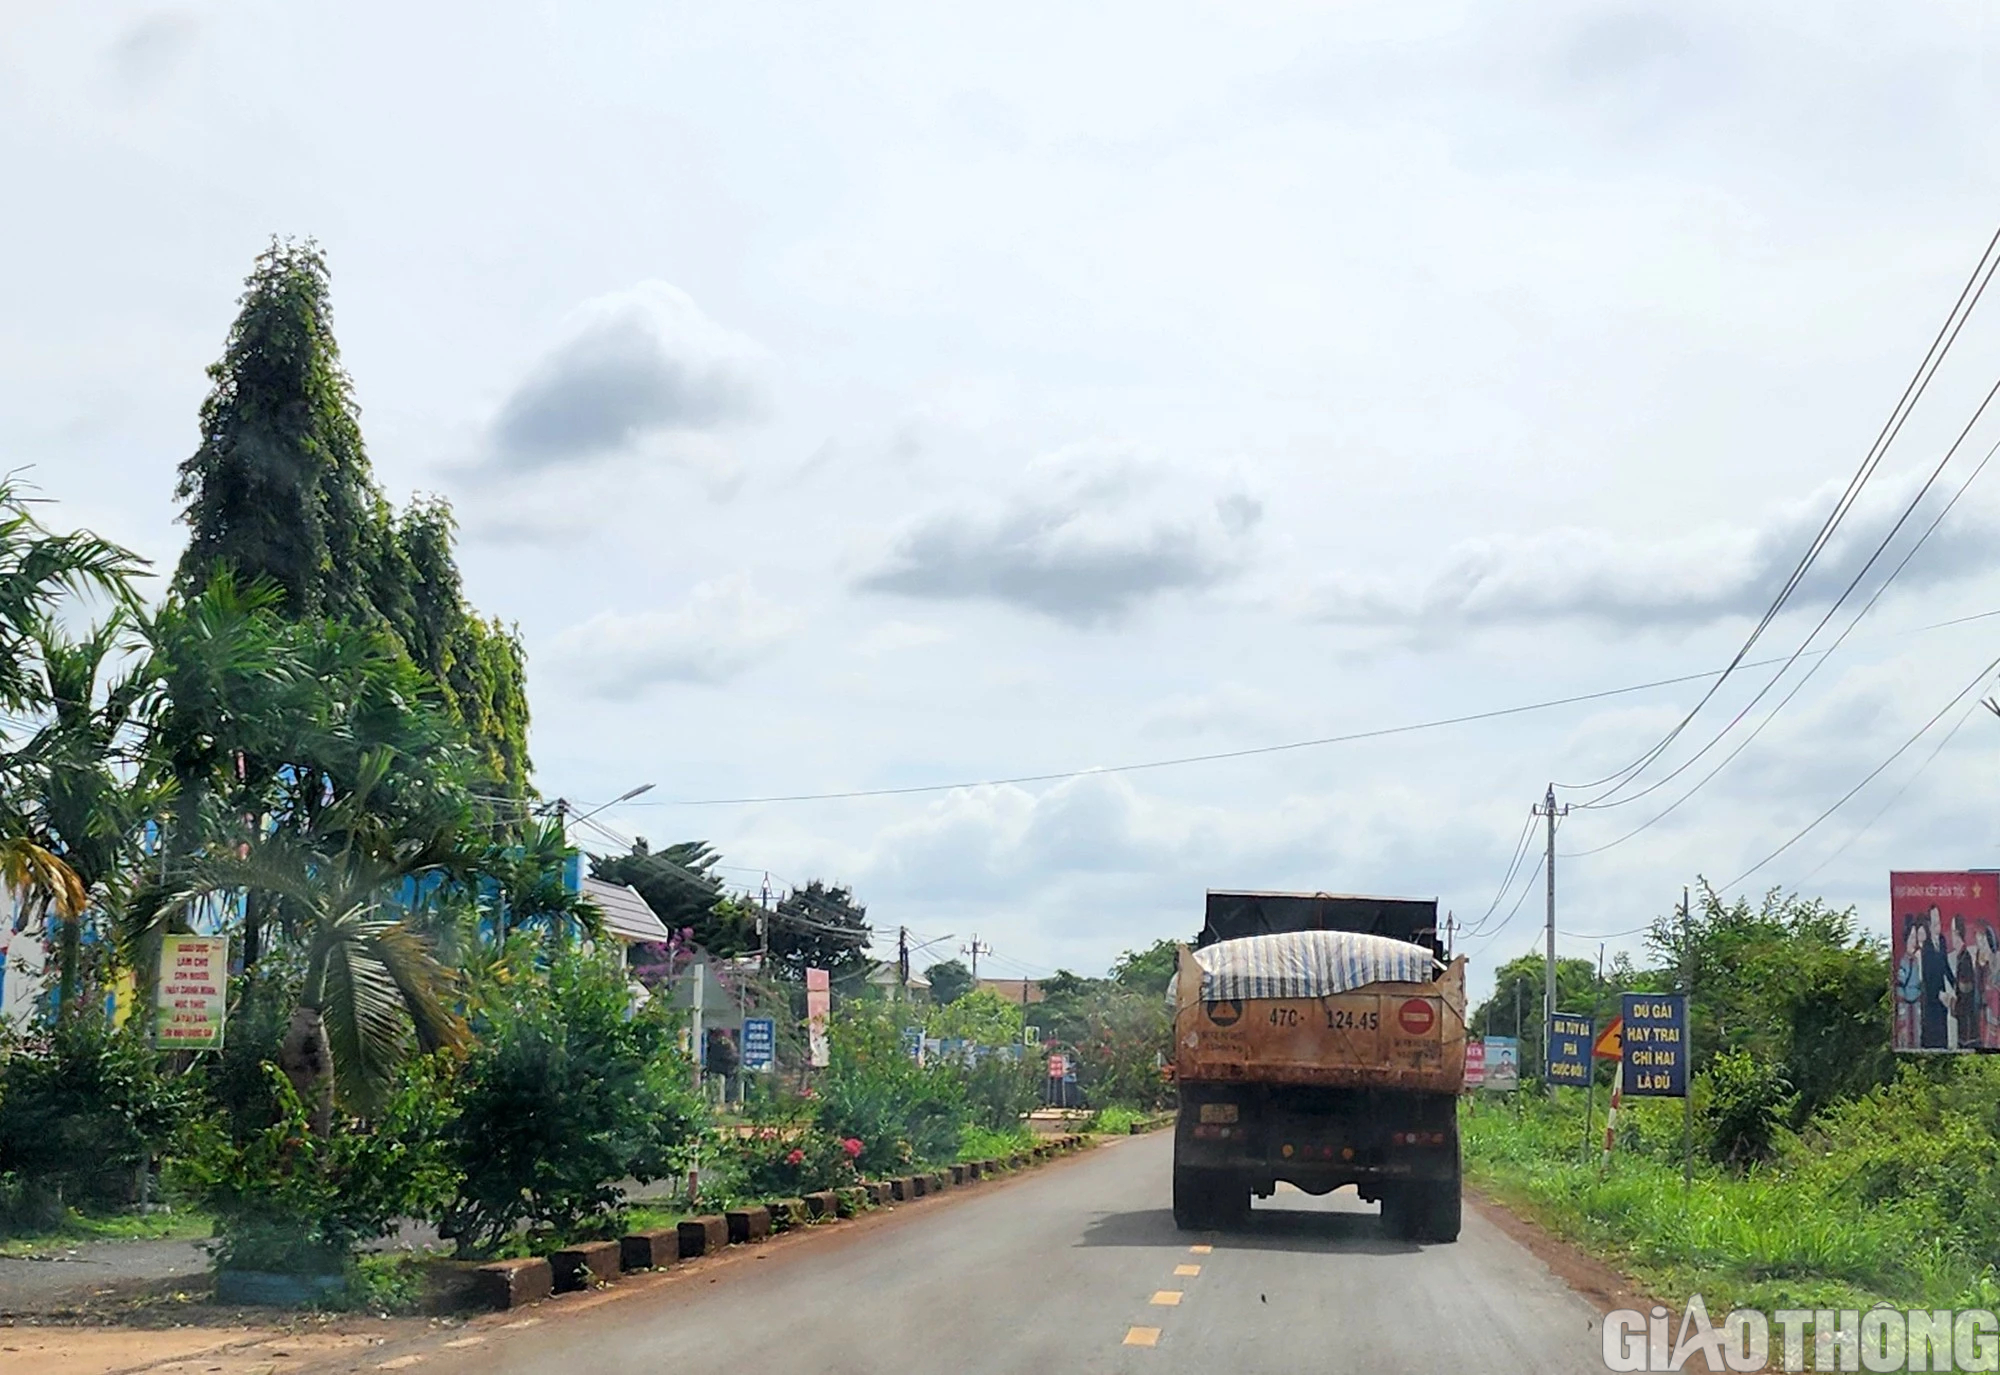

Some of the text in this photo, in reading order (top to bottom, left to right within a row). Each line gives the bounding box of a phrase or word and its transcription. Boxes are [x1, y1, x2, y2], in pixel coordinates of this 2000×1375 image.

[1327, 1010, 1378, 1030] 124.45
[1627, 1027, 1680, 1042] HAY TRAI
[1655, 1051, 1676, 1066] HAI
[1637, 1070, 1653, 1089] LÀ
